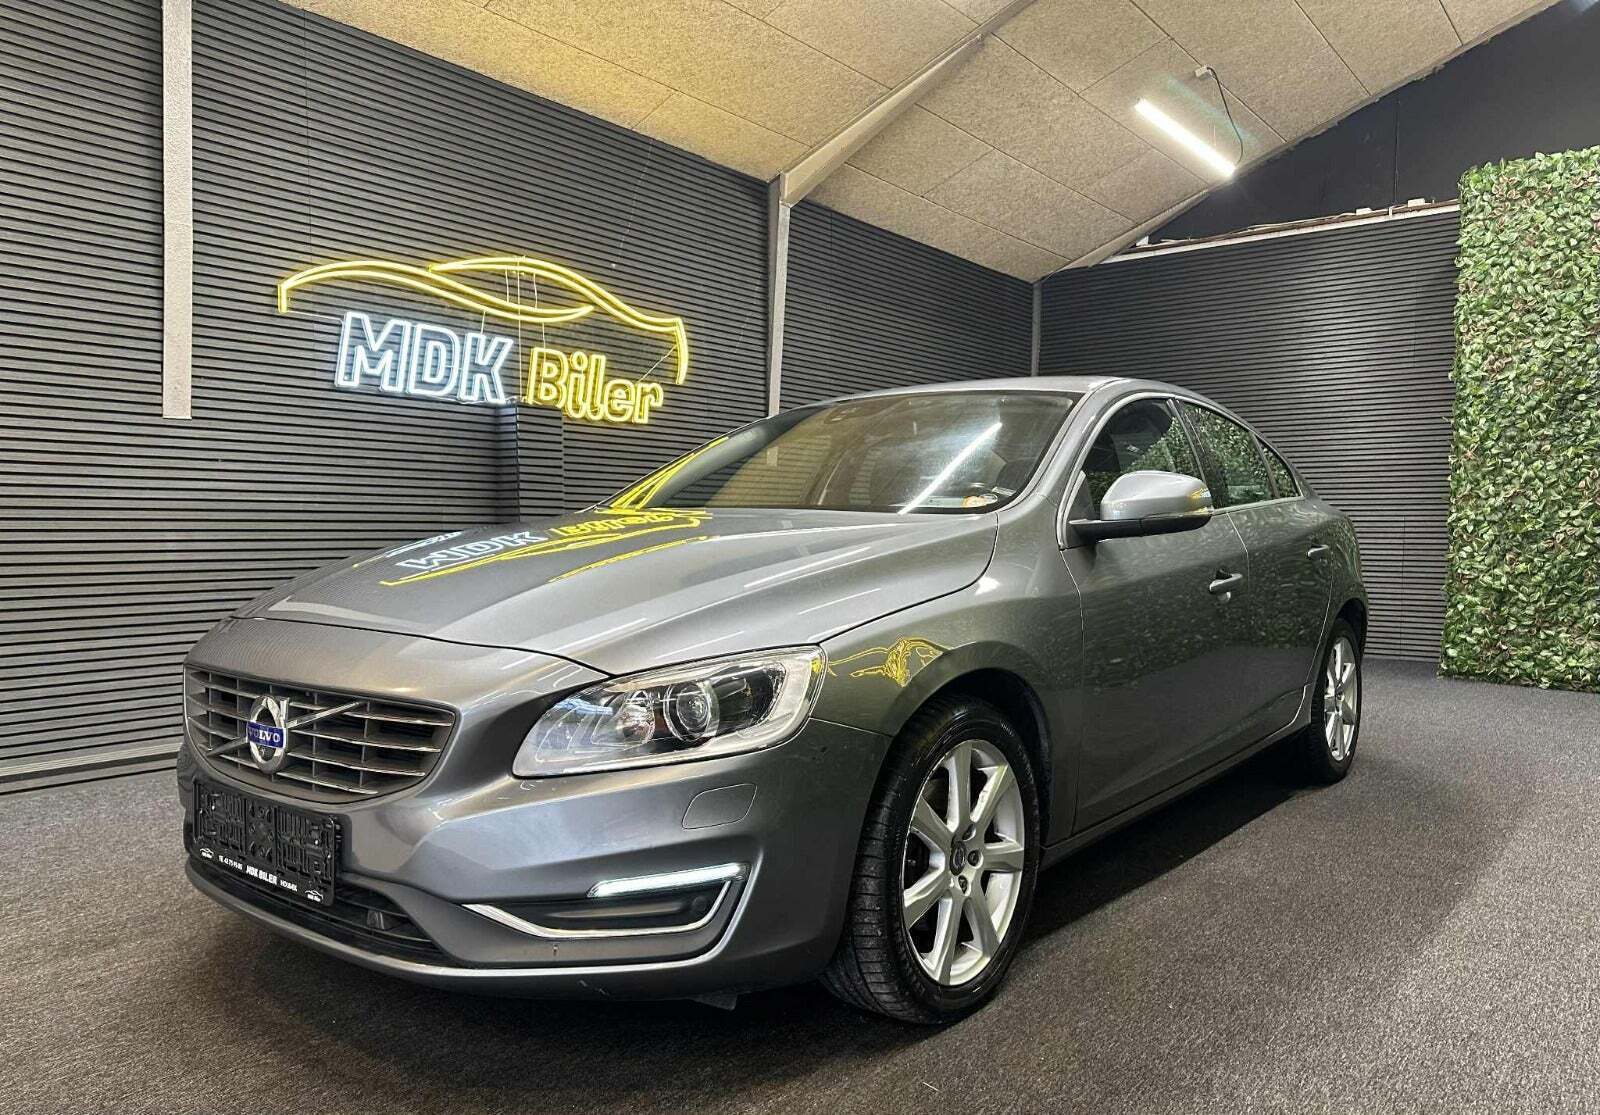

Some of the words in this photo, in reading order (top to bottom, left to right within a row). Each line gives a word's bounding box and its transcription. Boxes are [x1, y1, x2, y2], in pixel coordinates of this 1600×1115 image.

[334, 311, 514, 402] MDK
[527, 347, 664, 424] Biler
[247, 725, 281, 743] VOLVO
